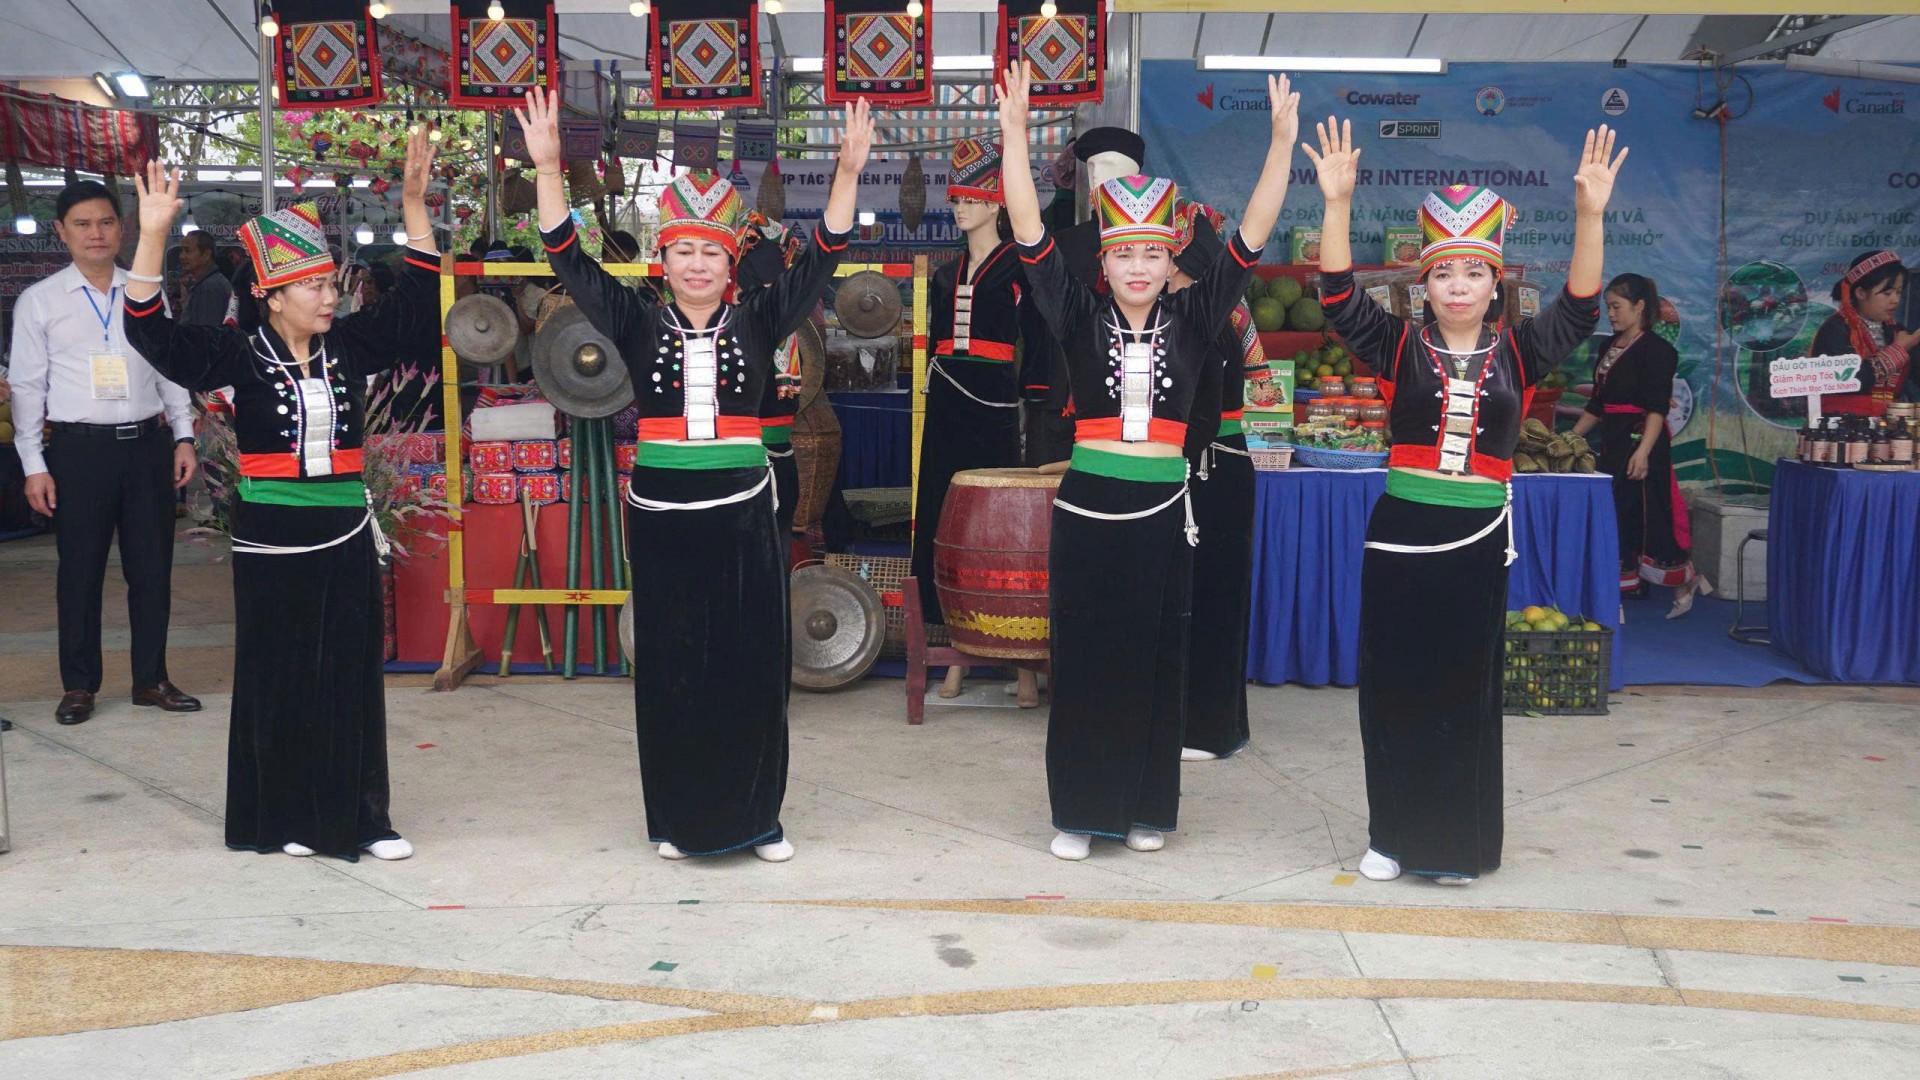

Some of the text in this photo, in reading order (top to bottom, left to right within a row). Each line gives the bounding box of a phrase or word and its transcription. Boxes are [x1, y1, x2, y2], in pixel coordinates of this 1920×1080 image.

[1346, 90, 1421, 106] Cowater
[1846, 98, 1905, 114] Canada
[799, 171, 825, 185] TÁC
[858, 171, 880, 185] IÊN
[1378, 168, 1549, 187] INTERNATIONAL
[1369, 203, 1417, 221] NĂNG
[1534, 210, 1568, 222] BAO
[1622, 207, 1645, 223] VÀ
[1504, 229, 1547, 247] GHIỆP
